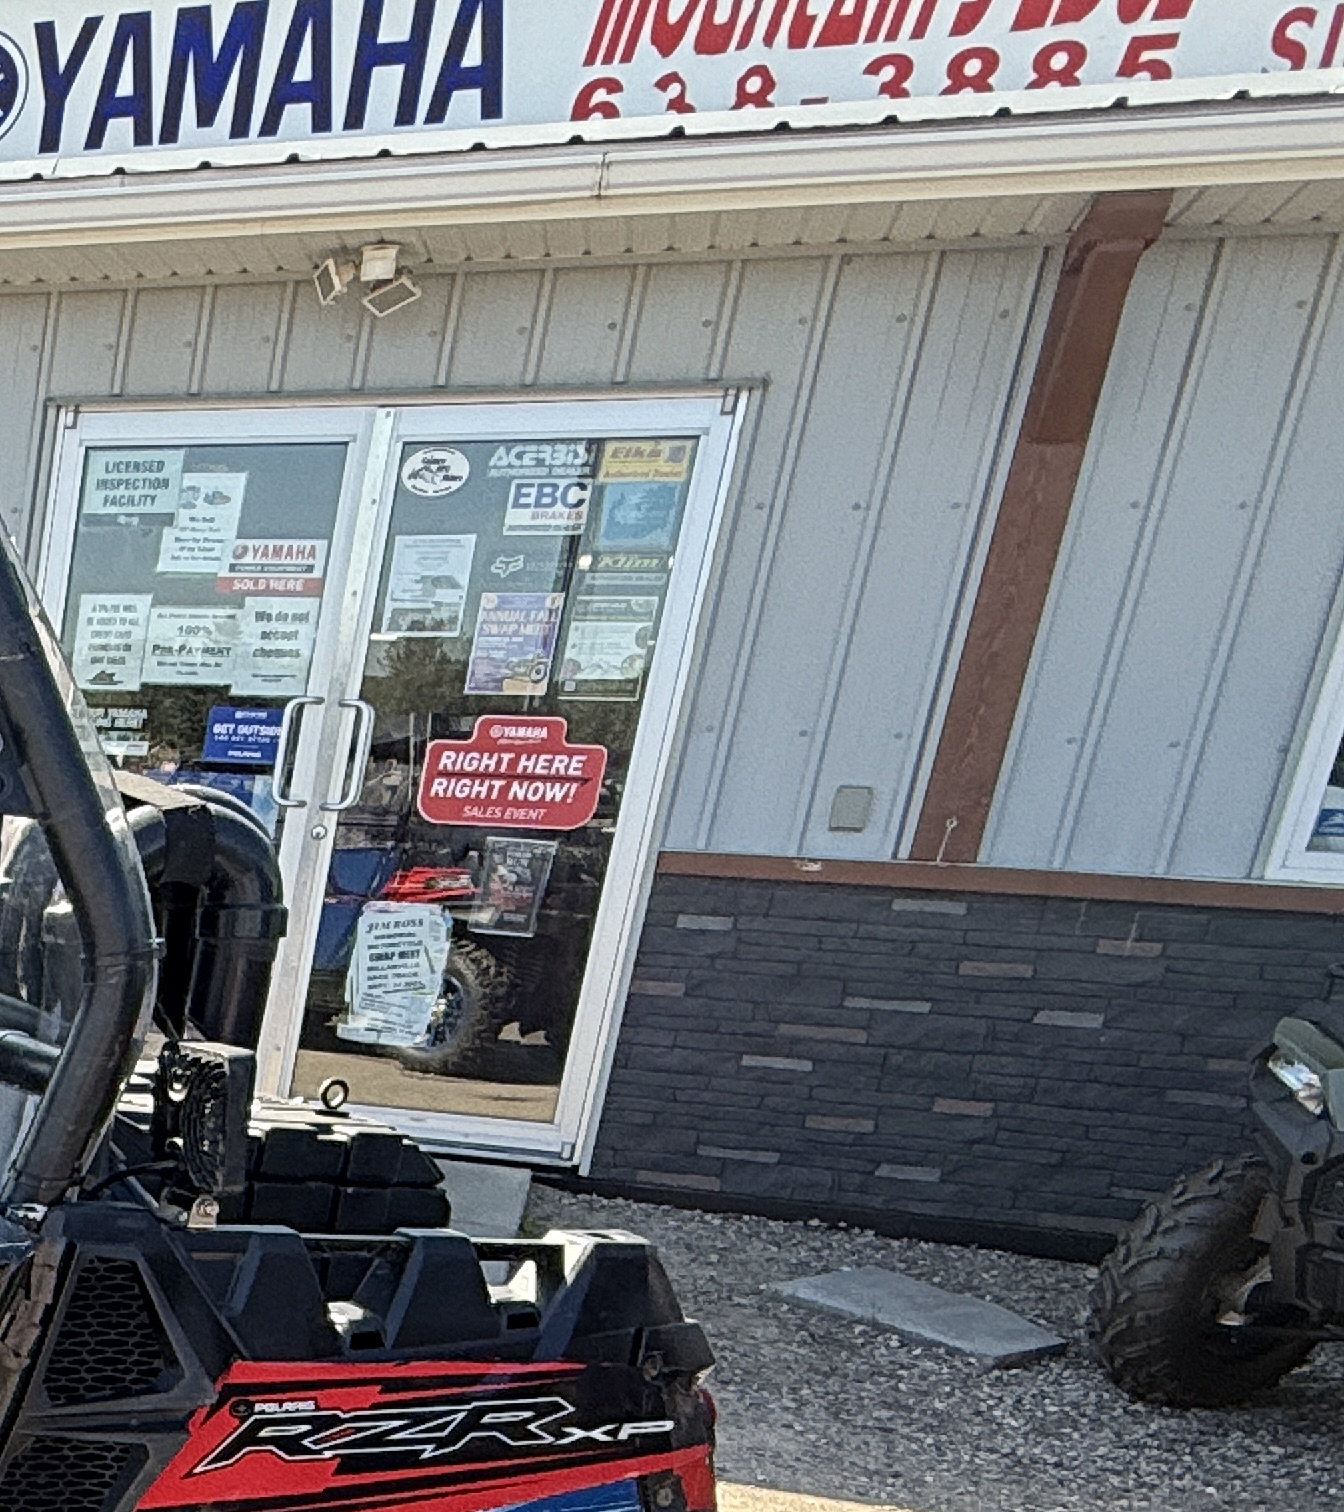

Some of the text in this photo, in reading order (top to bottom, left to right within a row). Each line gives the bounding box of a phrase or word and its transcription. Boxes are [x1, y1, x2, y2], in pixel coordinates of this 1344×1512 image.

[33, 0, 505, 154] YAMAHA
[104, 460, 166, 474] LICENSED
[95, 477, 170, 492] INSPECTION
[102, 494, 158, 508] FACILITY
[511, 482, 588, 510] EBC
[530, 510, 584, 521] BRAKES
[252, 544, 316, 561] YAMAHA
[232, 578, 305, 592] SOLD HERE
[254, 611, 311, 624] We do not
[438, 750, 588, 776] RIGHT HERE
[429, 777, 580, 804] RIGHT NOW!
[462, 805, 548, 820] SALES EVENT
[191, 1396, 676, 1477] RZR XP
